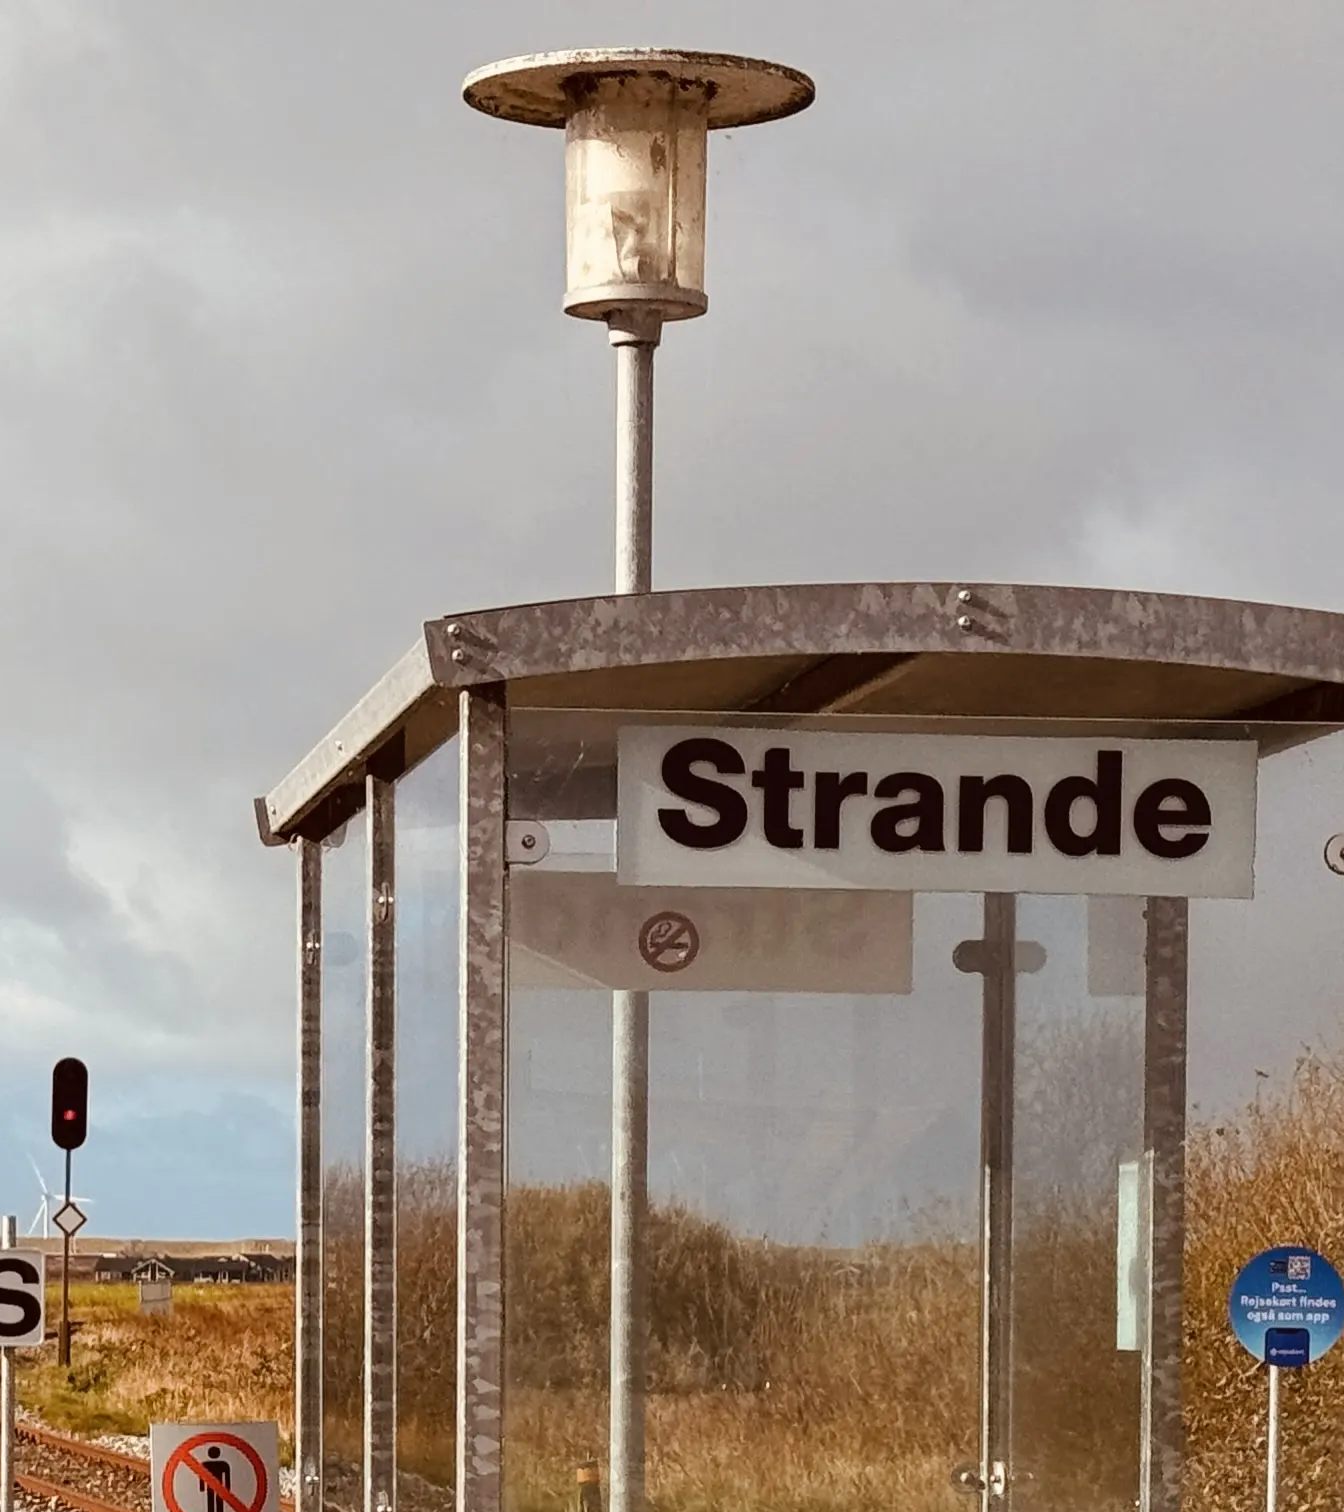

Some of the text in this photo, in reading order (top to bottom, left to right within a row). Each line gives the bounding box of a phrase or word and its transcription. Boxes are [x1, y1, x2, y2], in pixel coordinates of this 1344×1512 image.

[657, 737, 1213, 860] Strande
[1240, 1295, 1337, 1309] Rejsekort findes
[1246, 1309, 1330, 1324] også som app
